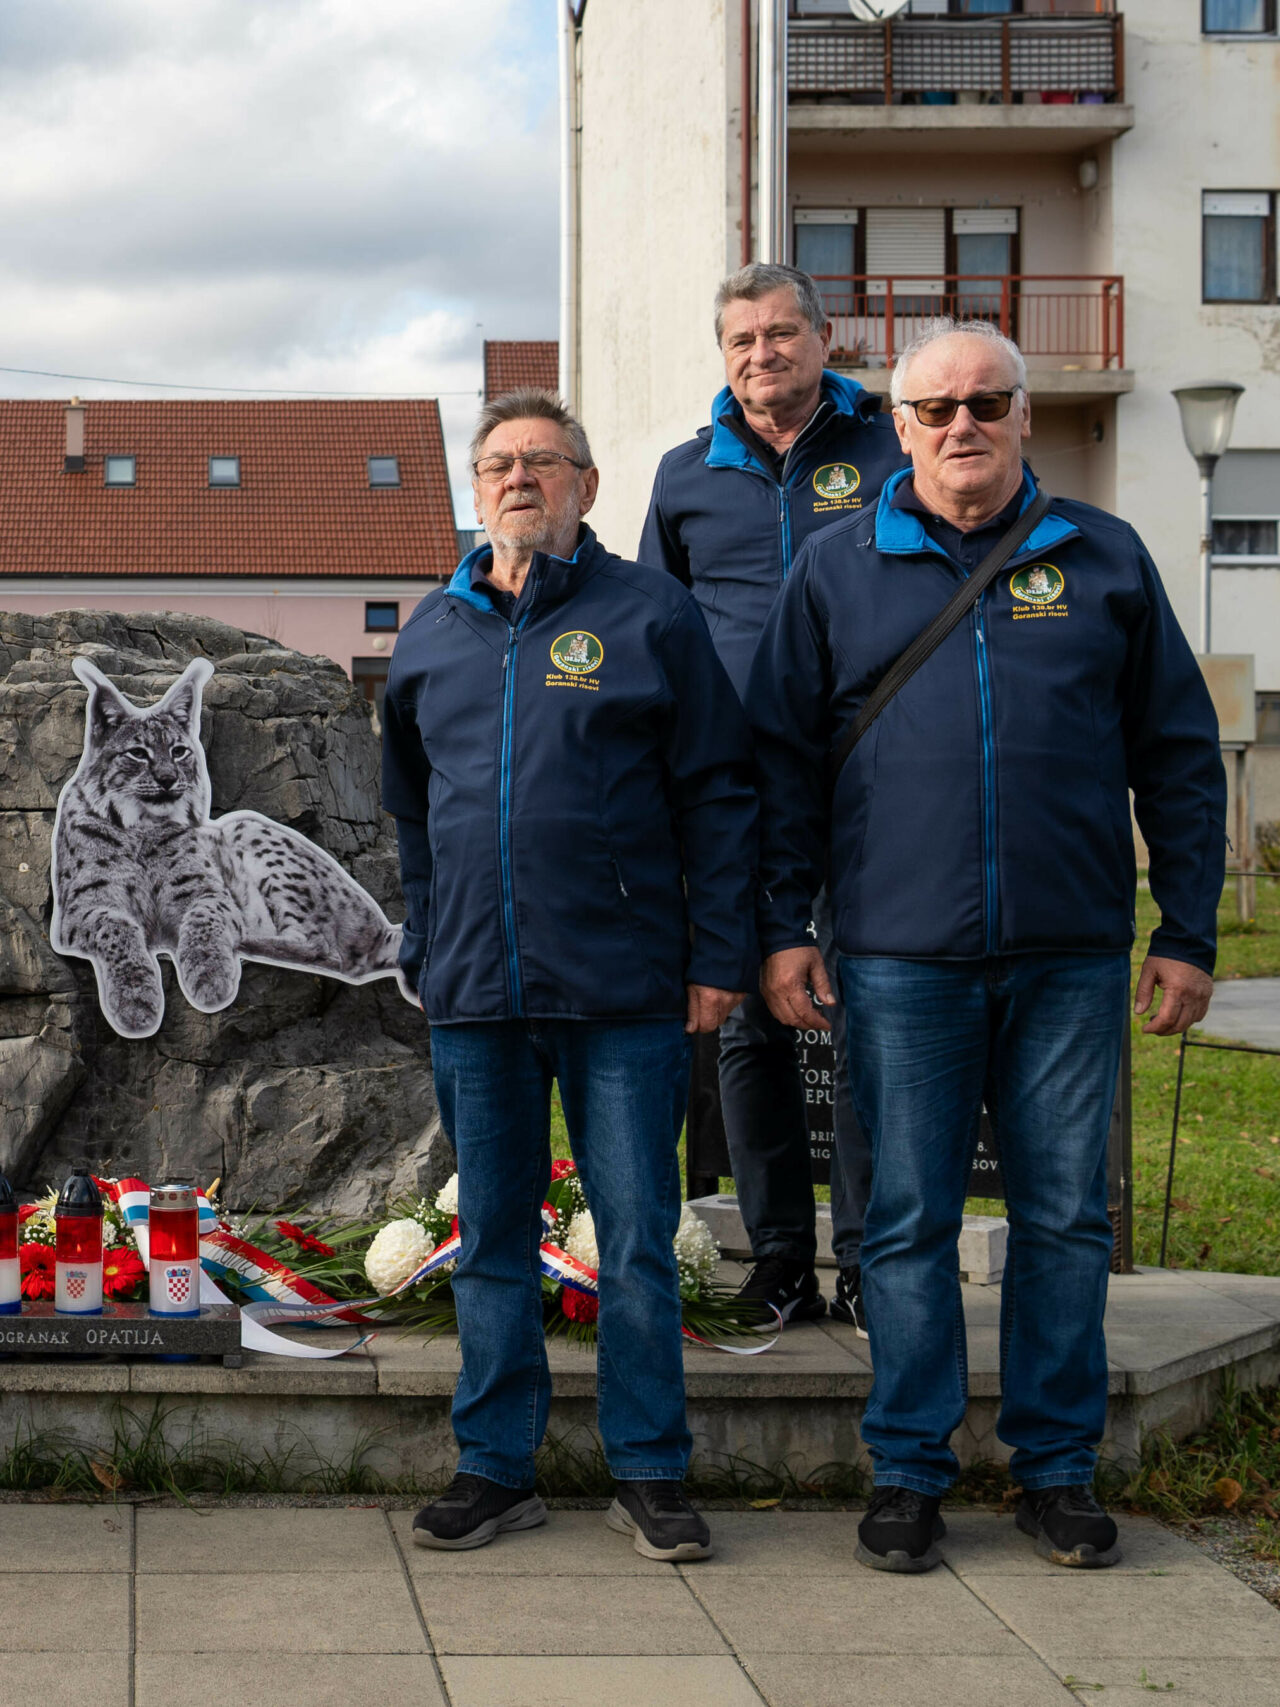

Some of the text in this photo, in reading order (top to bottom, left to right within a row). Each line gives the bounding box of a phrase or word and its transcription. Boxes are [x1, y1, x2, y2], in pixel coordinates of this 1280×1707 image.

[813, 505, 843, 513] Goranski
[1012, 611, 1047, 620] Goranski
[564, 674, 588, 683] 138.br
[545, 680, 599, 691] Goranski risovi
[86, 1327, 164, 1346] OPATIJA
